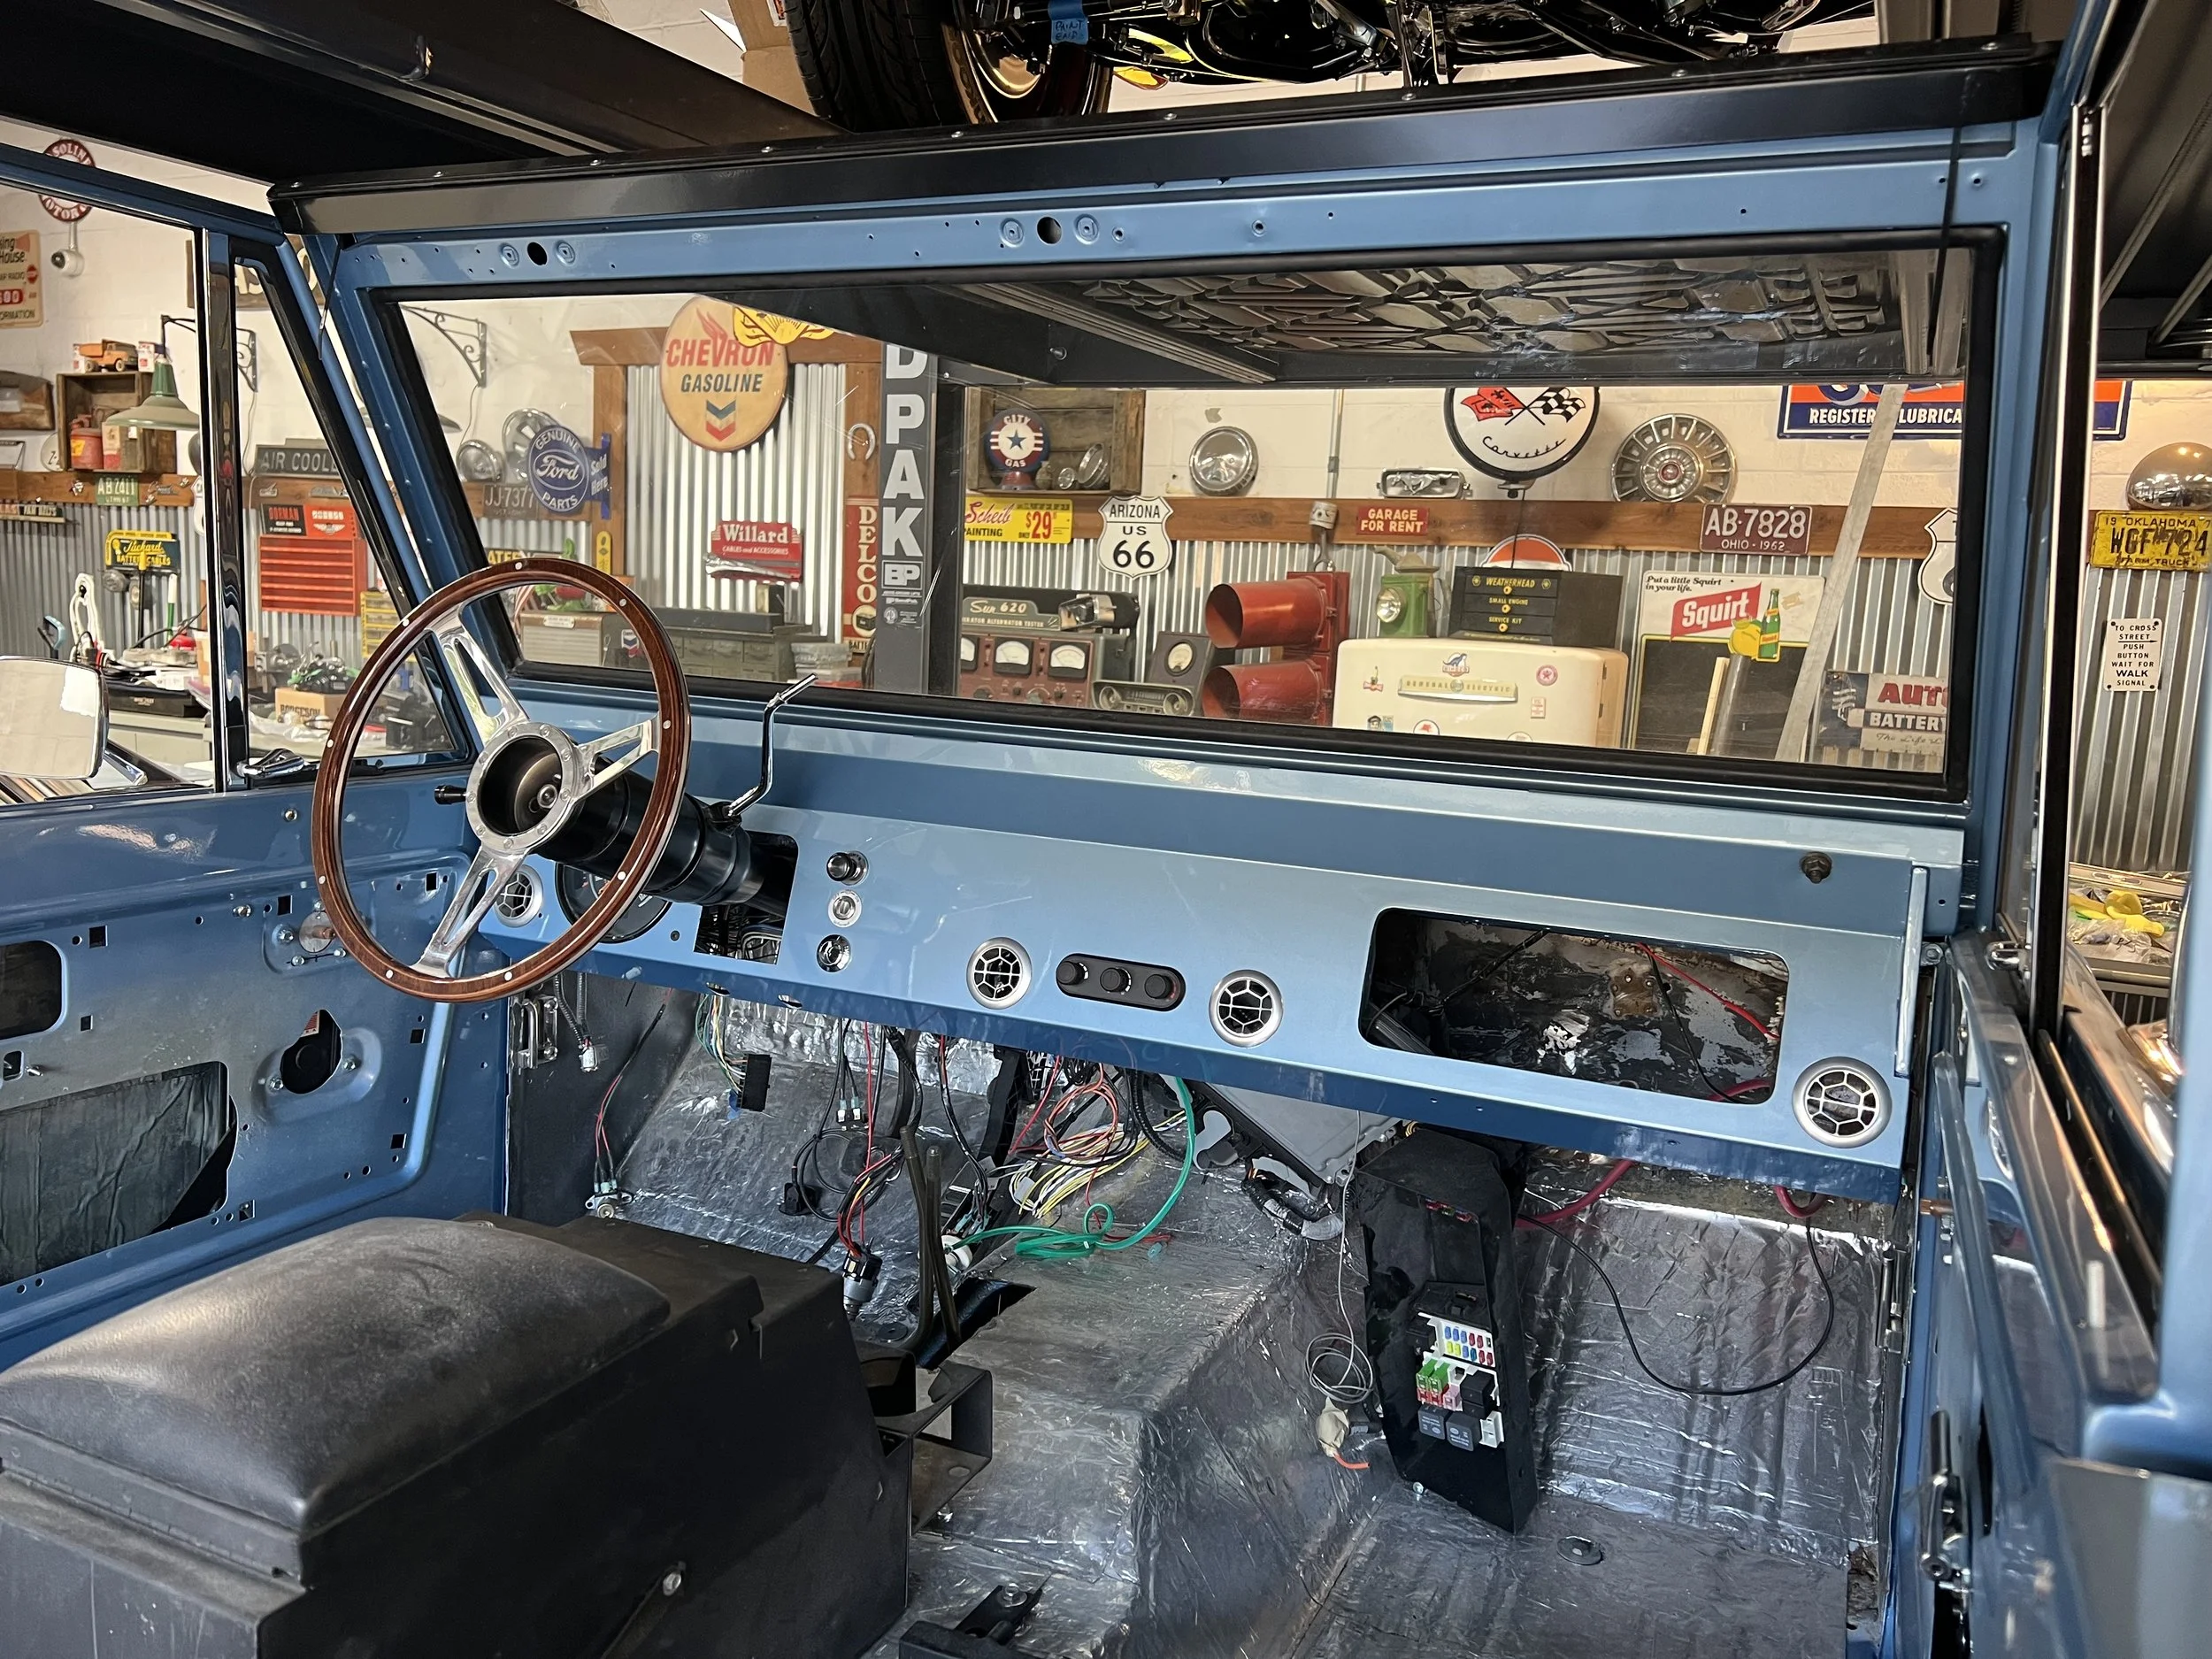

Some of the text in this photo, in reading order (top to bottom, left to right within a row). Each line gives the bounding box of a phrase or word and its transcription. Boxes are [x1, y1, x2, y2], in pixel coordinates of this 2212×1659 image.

[42, 196, 80, 219] OTOR
[666, 338, 776, 367] CHEVRON
[680, 373, 764, 393] GASOLINE
[1003, 414, 1032, 425] CITY
[535, 430, 582, 454] GENUINE
[1482, 435, 1567, 459] Corvette
[260, 450, 286, 471] AIR
[536, 454, 580, 481] Ford
[590, 453, 608, 476] Sold
[1004, 458, 1026, 468] GAS
[591, 477, 609, 496] Here
[541, 491, 579, 510] PARTS
[964, 500, 1016, 525] Scheib
[1109, 503, 1161, 518] ARIZONA
[1367, 508, 1418, 520] GARAGE
[1122, 525, 1148, 536] US
[1360, 519, 1424, 533] FOR RENT
[2125, 517, 2196, 528] OKLAHOMA
[722, 523, 789, 544] Willard
[964, 527, 1003, 537] AINTING
[1721, 539, 1786, 551] OHIO 1962
[856, 505, 878, 603] DELCO
[1112, 539, 1155, 569] 66
[2155, 557, 2190, 566] TRUCK
[1486, 577, 1536, 588] WEATHERHEAD
[1646, 575, 1663, 584] Put
[1671, 575, 1691, 584] little
[1693, 577, 1722, 587] Squirt
[1677, 583, 1692, 593] life.
[970, 599, 1027, 613] Sun 620
[1681, 591, 1750, 629] Squirt
[2116, 669, 2149, 678] WALK
[1406, 680, 1448, 689] GENERAL
[1877, 682, 1948, 707] AUT
